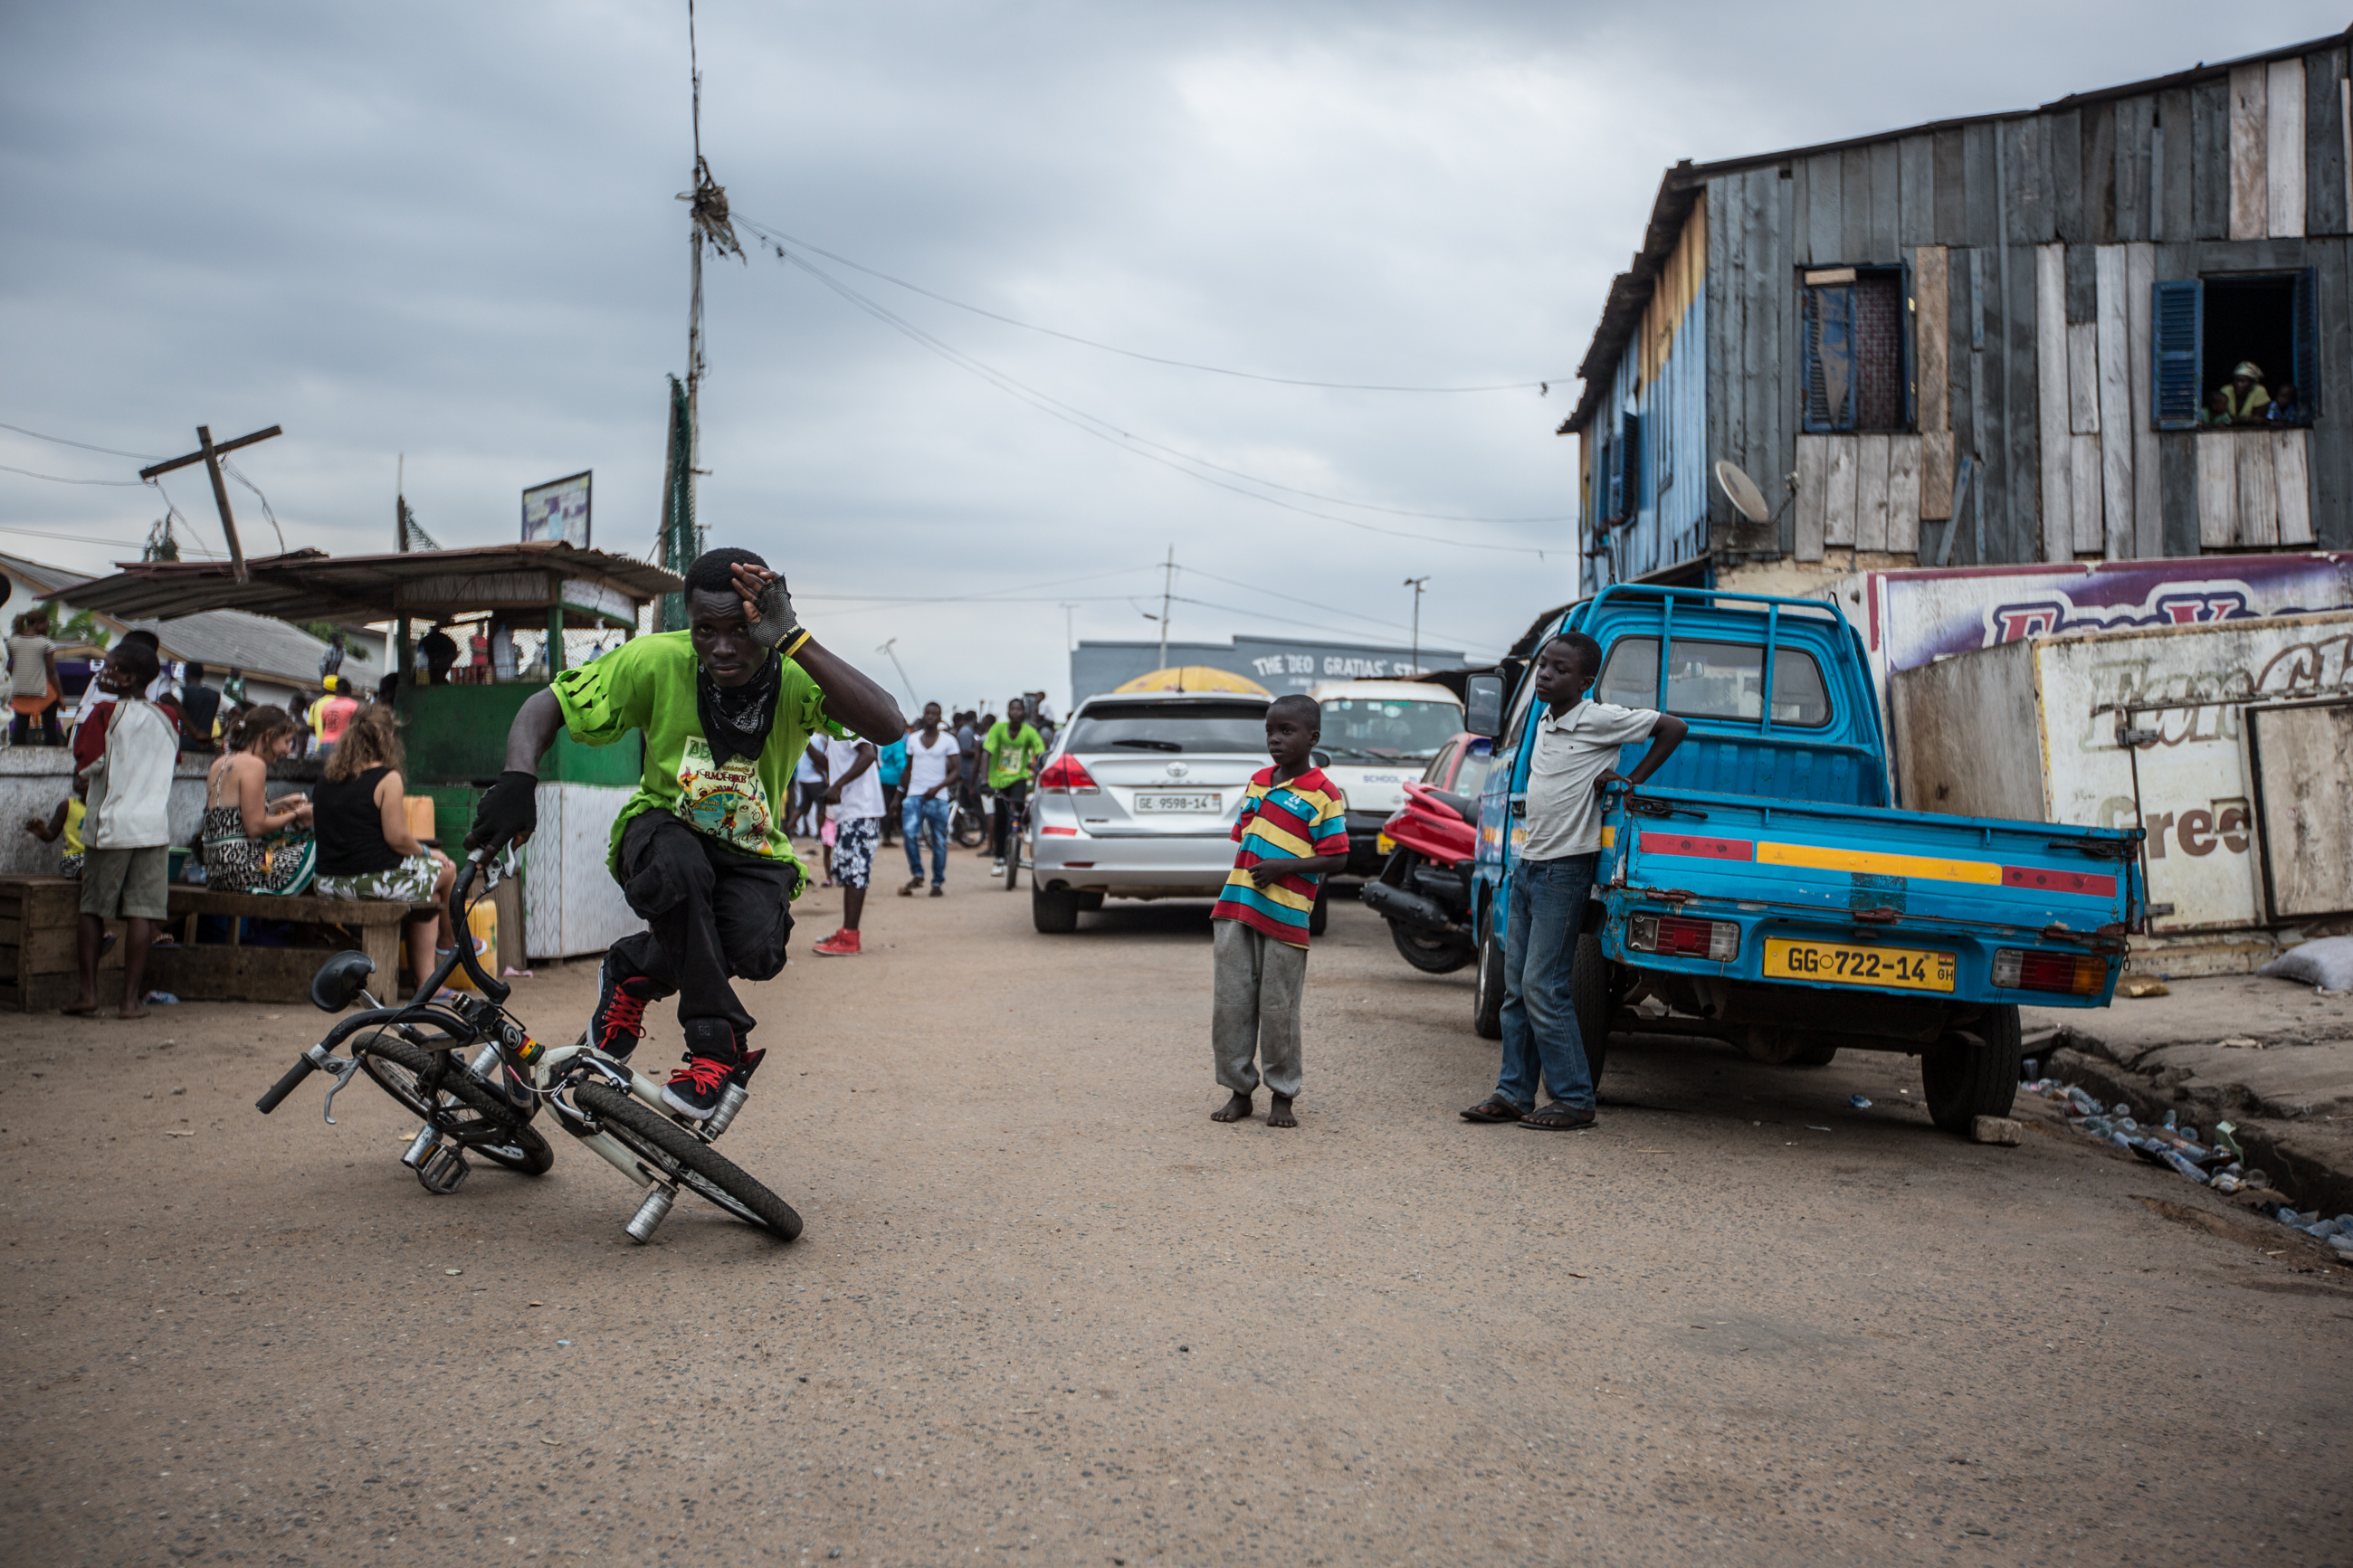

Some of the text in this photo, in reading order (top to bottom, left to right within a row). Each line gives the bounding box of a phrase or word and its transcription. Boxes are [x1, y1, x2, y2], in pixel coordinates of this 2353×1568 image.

[1252, 654, 1285, 678] THE
[1362, 774, 1401, 784] SCHOOL
[1138, 797, 1154, 809] GE
[1159, 797, 1207, 809] 9598-14
[1289, 792, 1303, 805] 24
[1788, 947, 1955, 982] GG 722-14 GH
